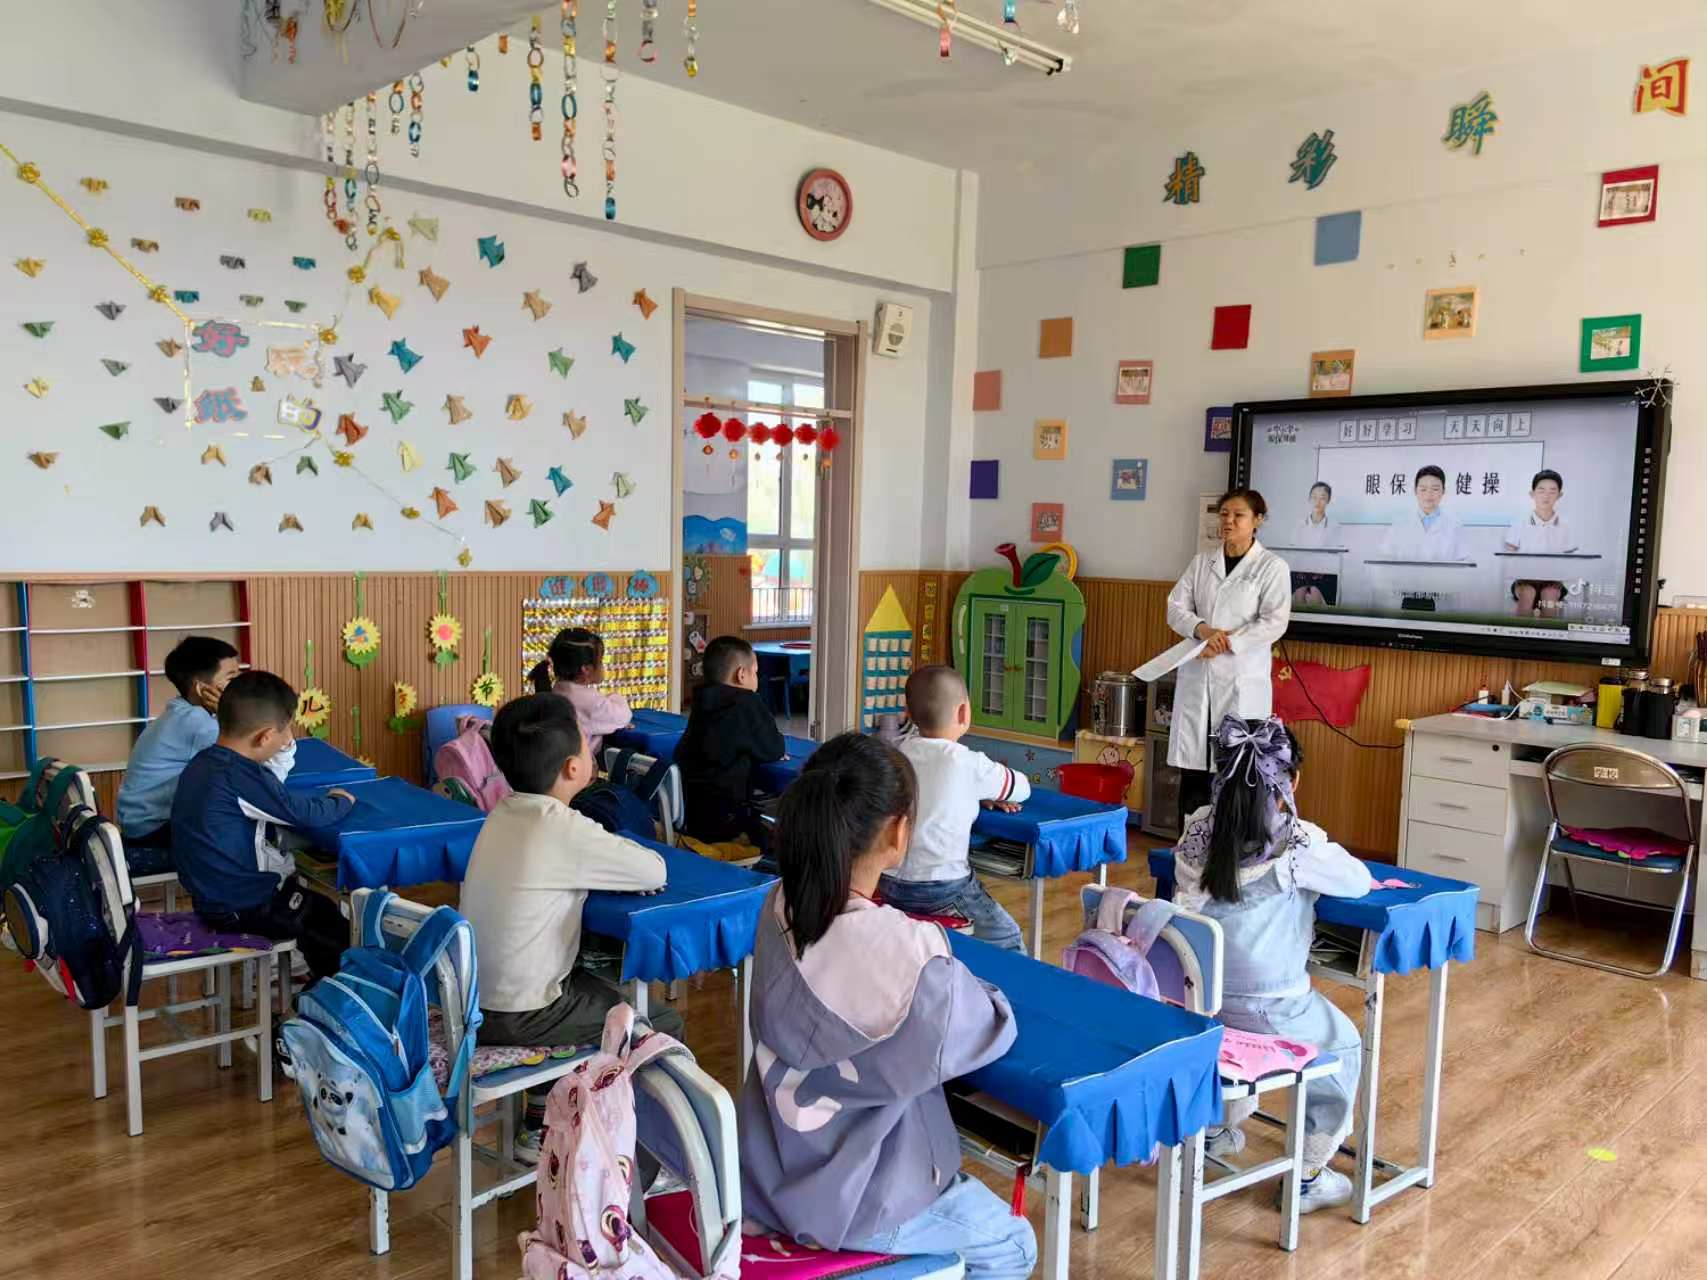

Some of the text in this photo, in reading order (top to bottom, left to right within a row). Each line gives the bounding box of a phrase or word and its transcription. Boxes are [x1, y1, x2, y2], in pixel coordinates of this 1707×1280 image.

[1342, 421, 1413, 438] 好好学习
[1450, 418, 1530, 433] 天天向上
[1366, 472, 1500, 495] 眼保健操
